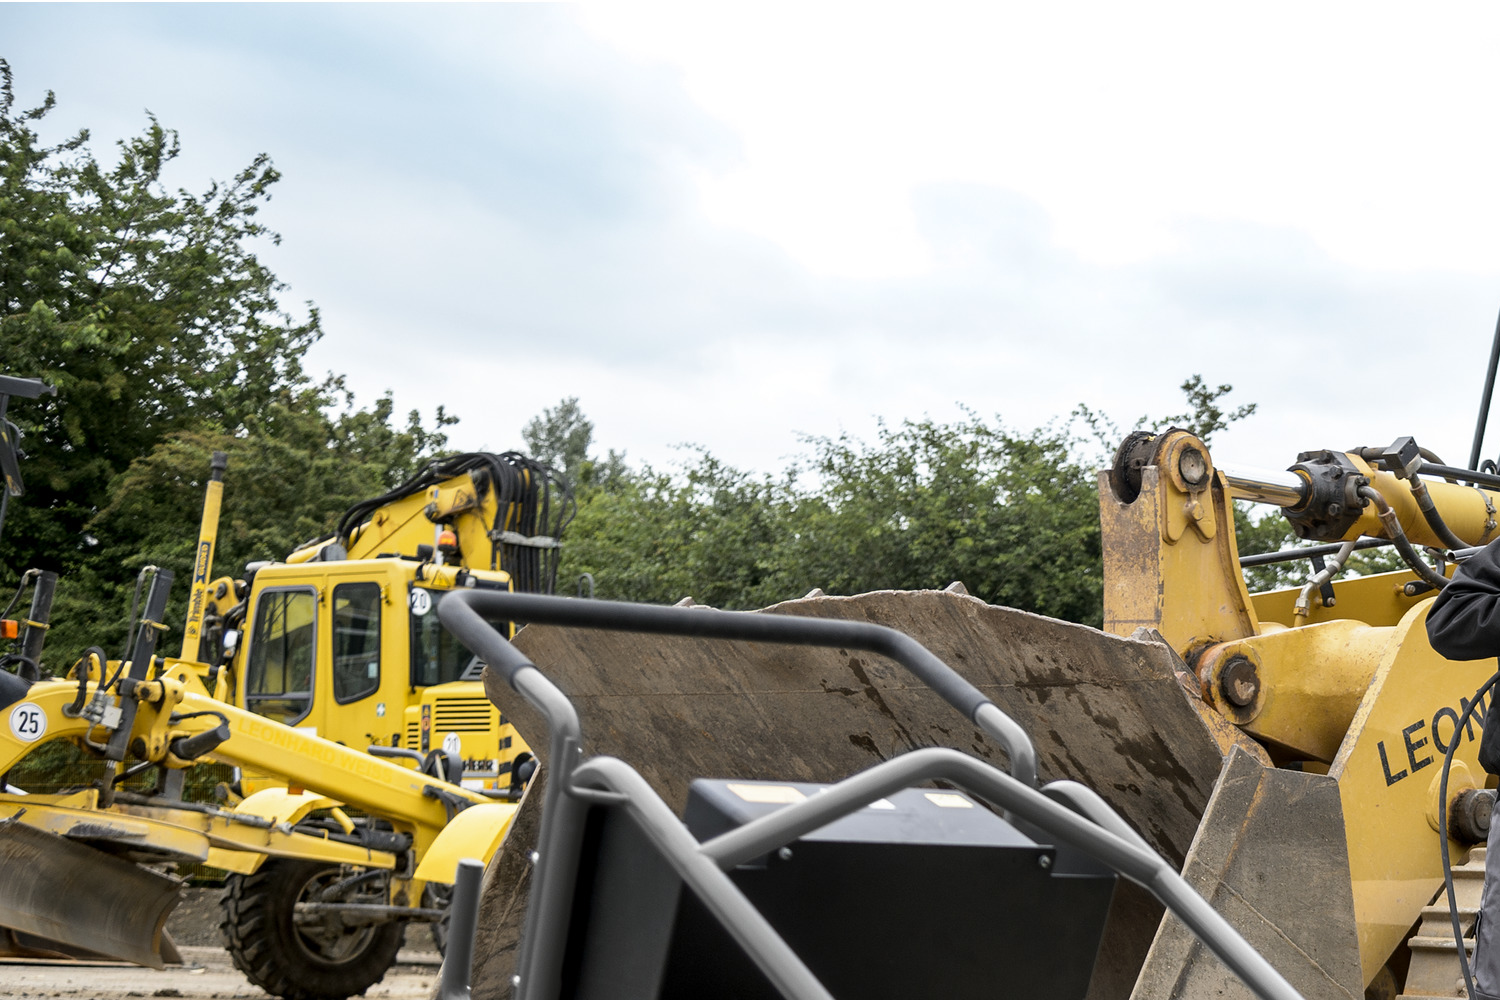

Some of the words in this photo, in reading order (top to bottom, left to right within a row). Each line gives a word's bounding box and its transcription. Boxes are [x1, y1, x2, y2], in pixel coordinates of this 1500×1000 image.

[18, 710, 39, 734] 25
[238, 717, 336, 765] LEONHARD
[1376, 685, 1495, 787] LEON
